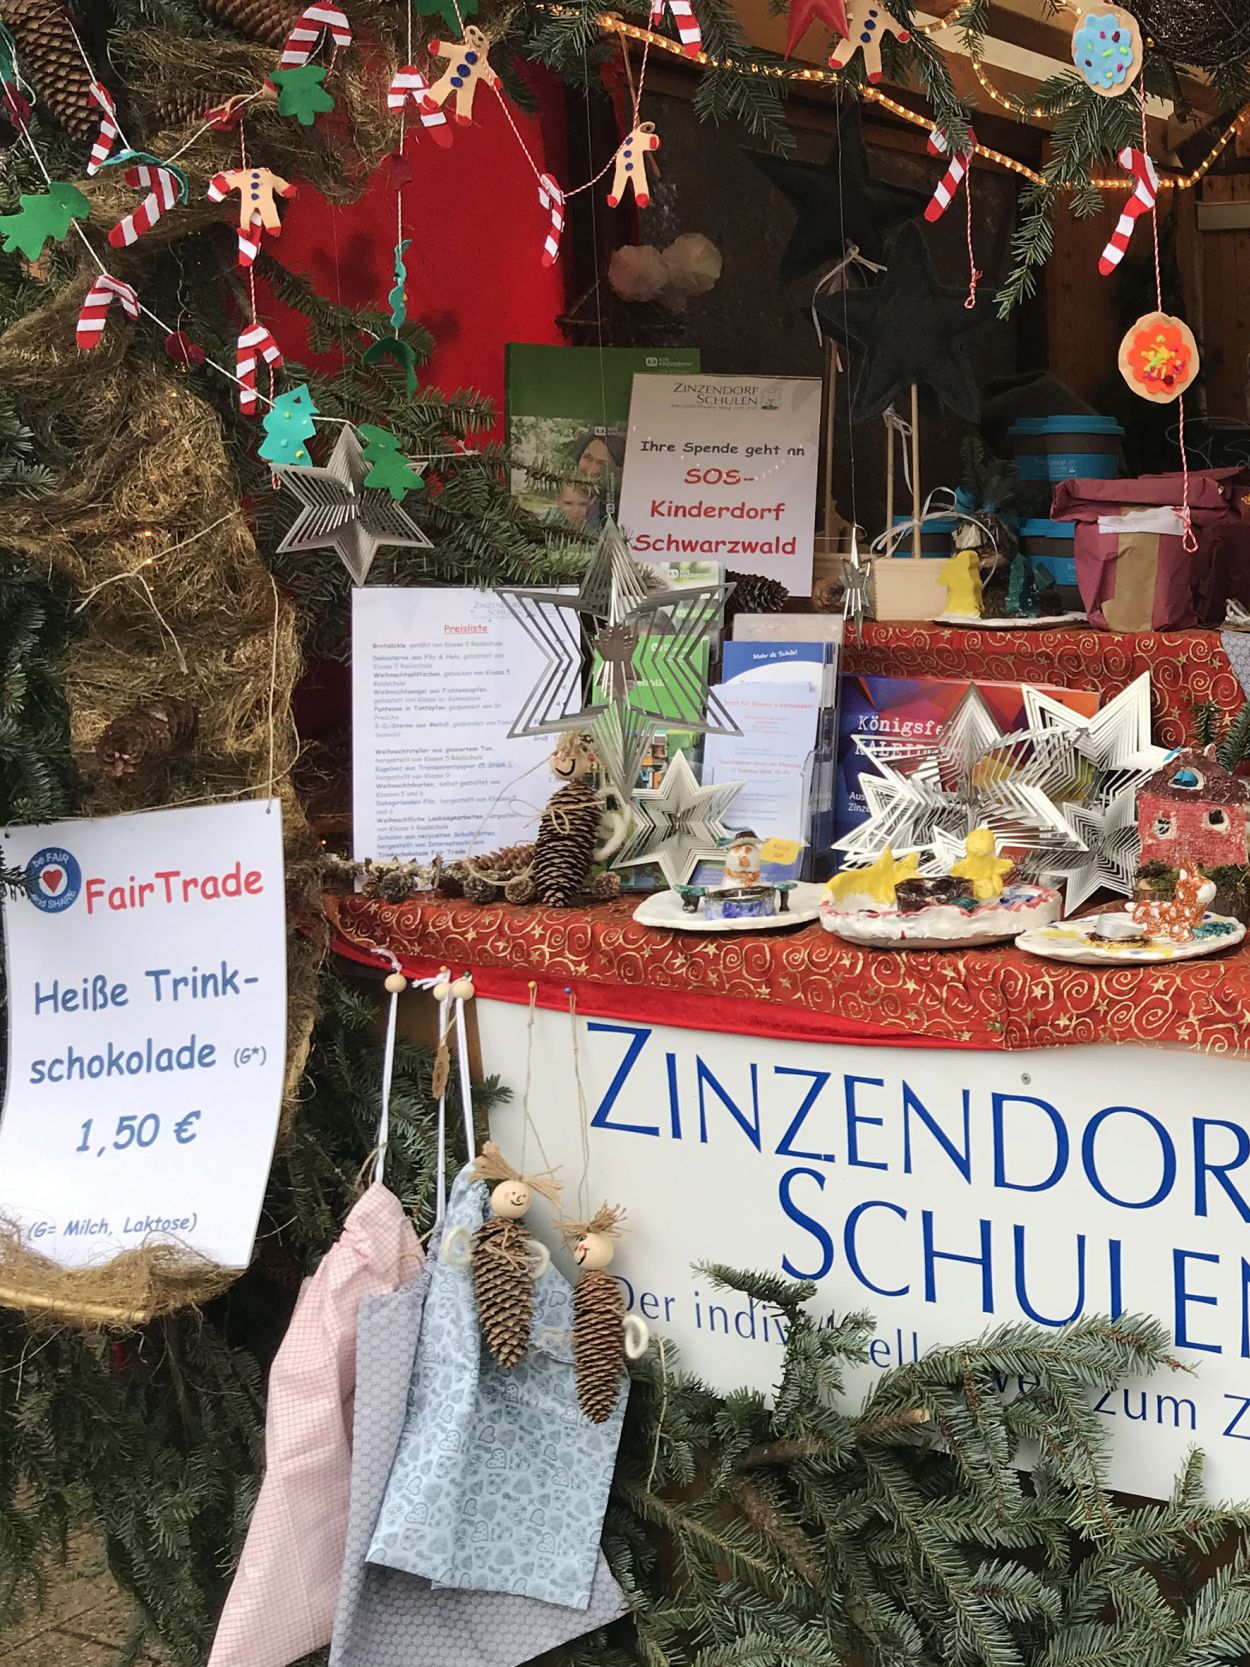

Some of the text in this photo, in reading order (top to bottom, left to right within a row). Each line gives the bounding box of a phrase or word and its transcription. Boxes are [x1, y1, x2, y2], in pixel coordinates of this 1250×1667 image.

[672, 382, 759, 396] ZINZENDORF
[696, 394, 759, 406] SCHULEN
[640, 440, 676, 452] Ihre
[682, 442, 738, 456] Spende
[745, 445, 781, 457] geht
[684, 468, 755, 486] SOS-
[650, 500, 786, 521] Kinderdorf
[632, 534, 797, 555] Schwarzwald
[444, 624, 489, 634] Preisliste
[857, 715, 946, 738] Königsfe
[46, 852, 70, 864] FAIR
[85, 861, 264, 914] FairTrade
[34, 960, 260, 1015] Heiße Trink-
[30, 1034, 217, 1084] schokolade
[75, 1110, 202, 1157] 1,50 €
[63, 1218, 112, 1238] Milch,
[123, 1212, 197, 1235] Laktose)
[1093, 1384, 1198, 1430] zum
